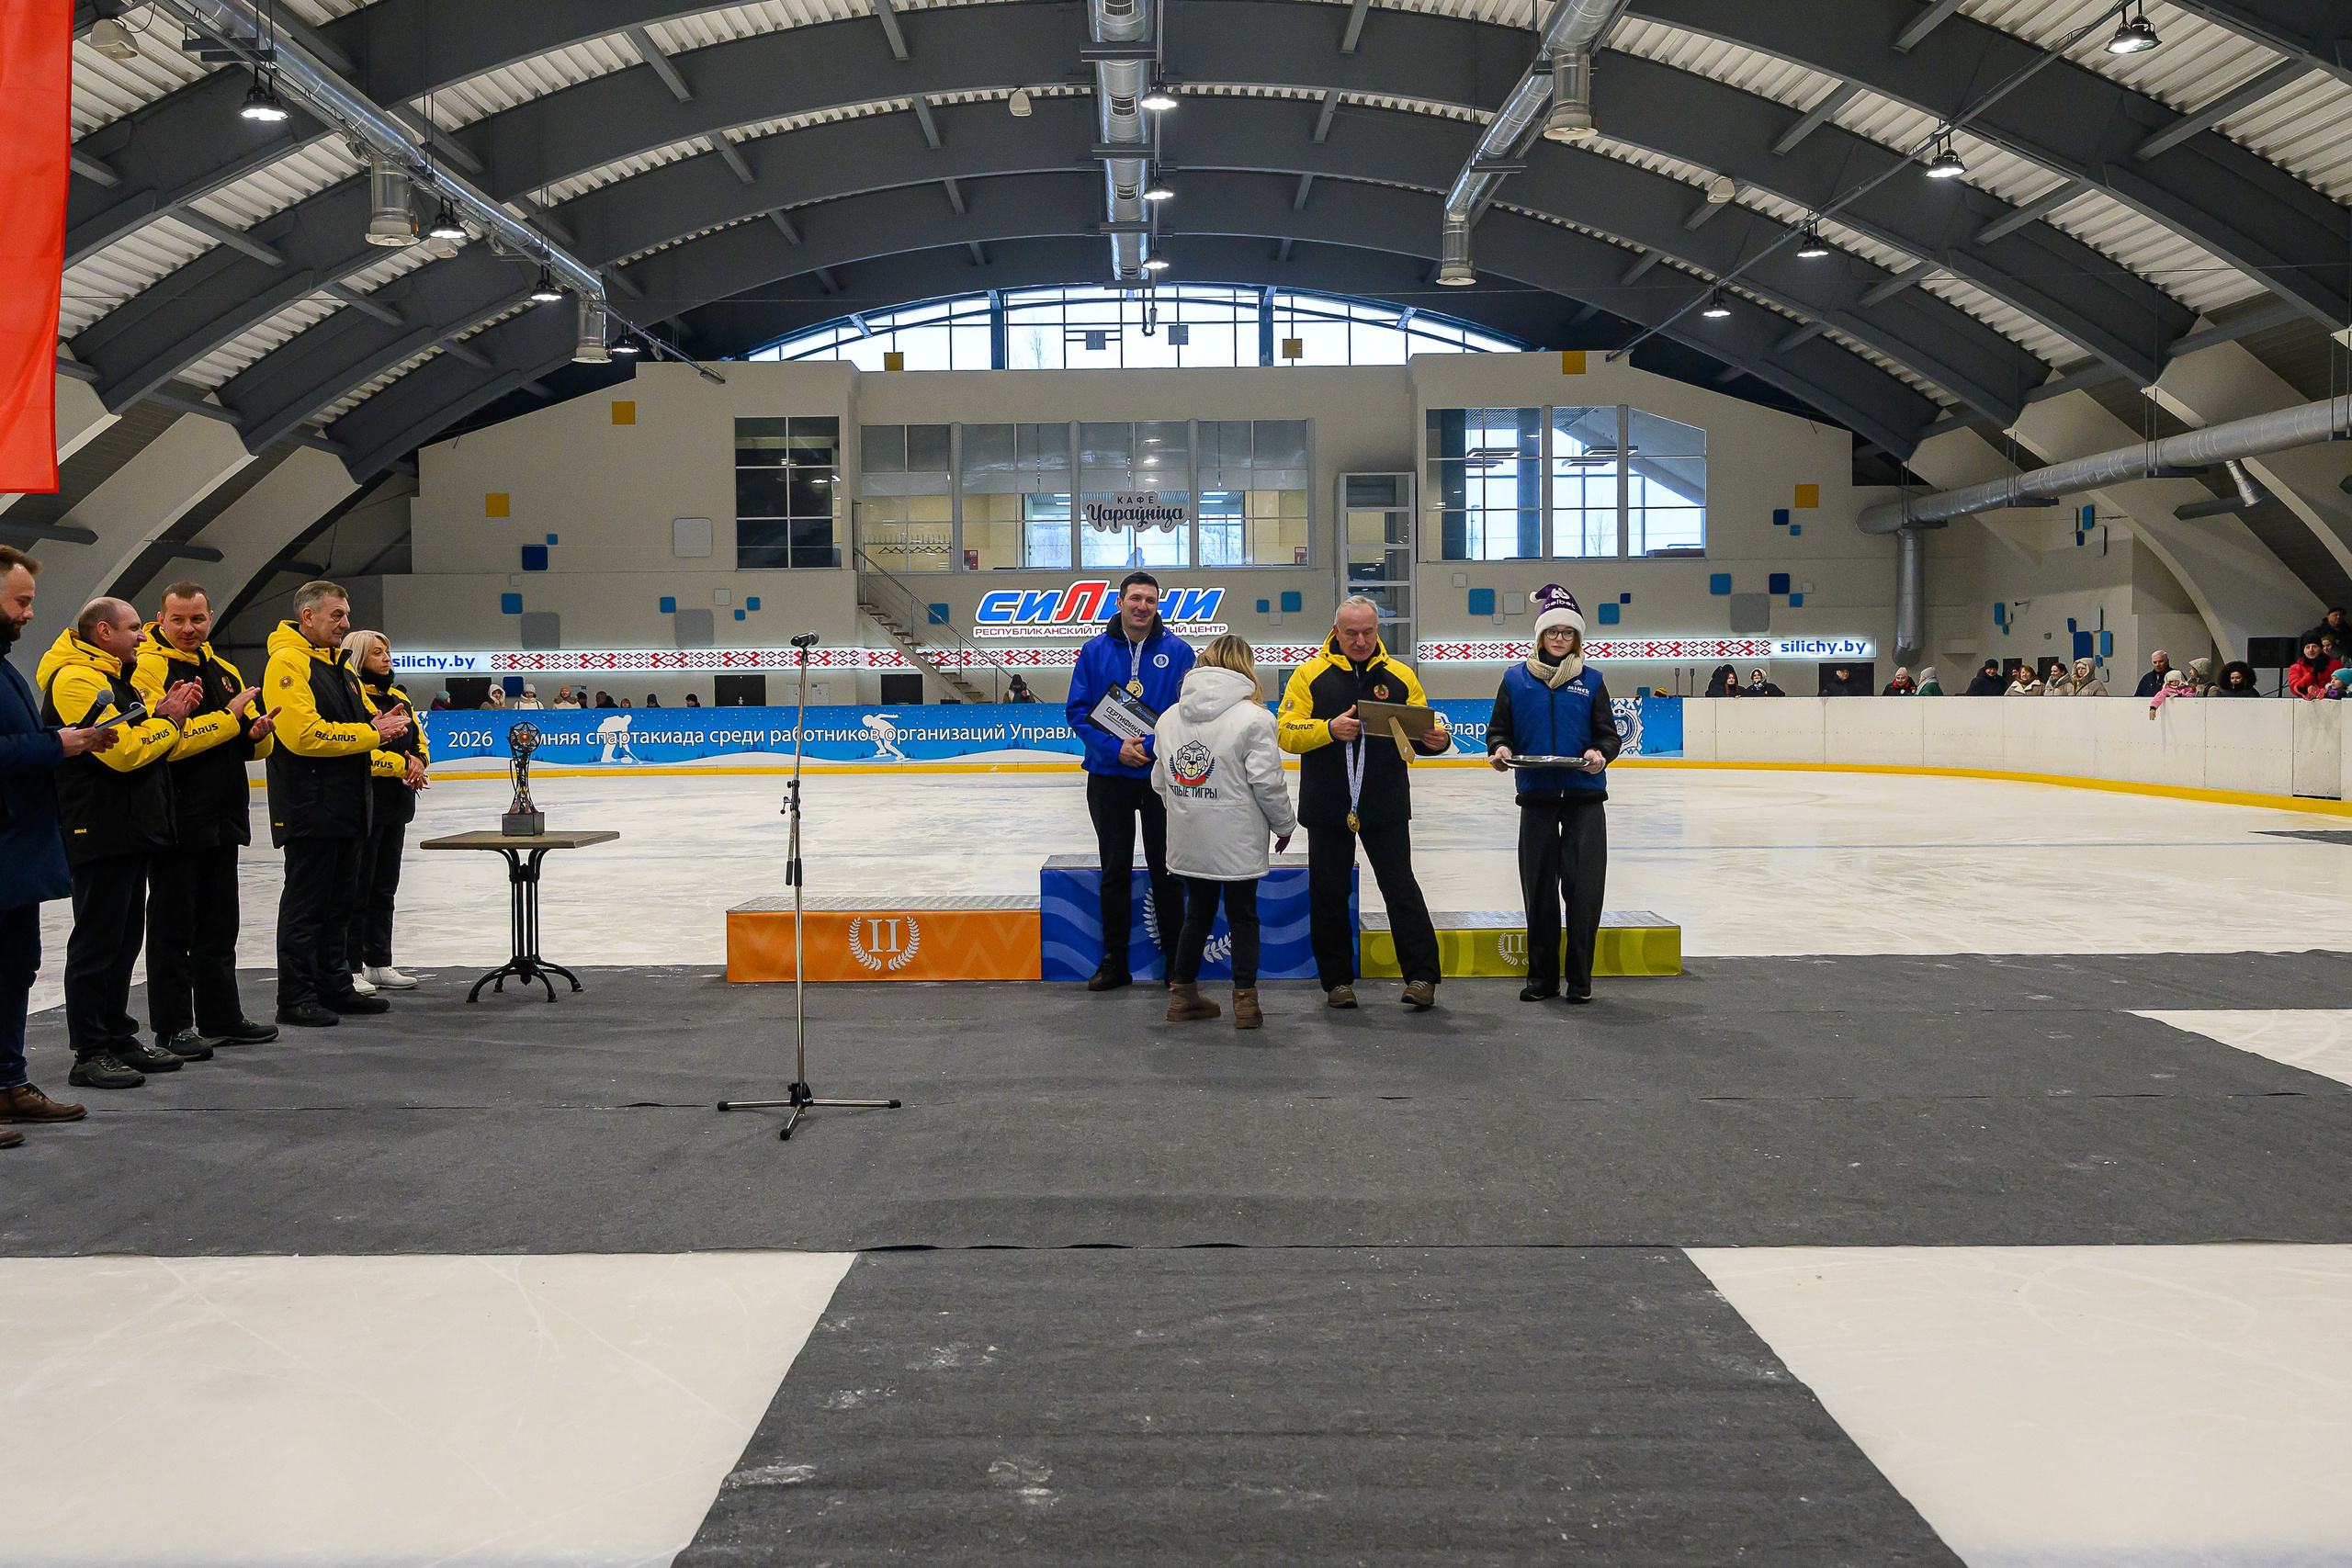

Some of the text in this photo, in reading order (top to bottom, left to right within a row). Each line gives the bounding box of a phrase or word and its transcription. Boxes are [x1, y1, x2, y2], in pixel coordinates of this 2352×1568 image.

[1117, 496, 1154, 504] КАФЕ
[1544, 599, 1576, 609] belbet
[975, 626, 1092, 636] РЕСПУБЛИКАНСКИЙ
[1190, 626, 1227, 634] ЦЕНТР
[1781, 640, 1866, 654] silichy.by
[392, 655, 475, 670] silichy.by
[314, 730, 356, 742] BELARUS
[447, 730, 493, 748] 2026
[535, 731, 580, 746] мняя
[585, 729, 705, 748] спартакиада
[709, 728, 765, 749] среди
[770, 726, 881, 746] работников
[884, 724, 1006, 745] организаций
[1009, 723, 1078, 744] Управл
[1191, 786, 1218, 798] ТИГРЫ
[866, 919, 901, 953] II
[1506, 933, 1528, 953] II
